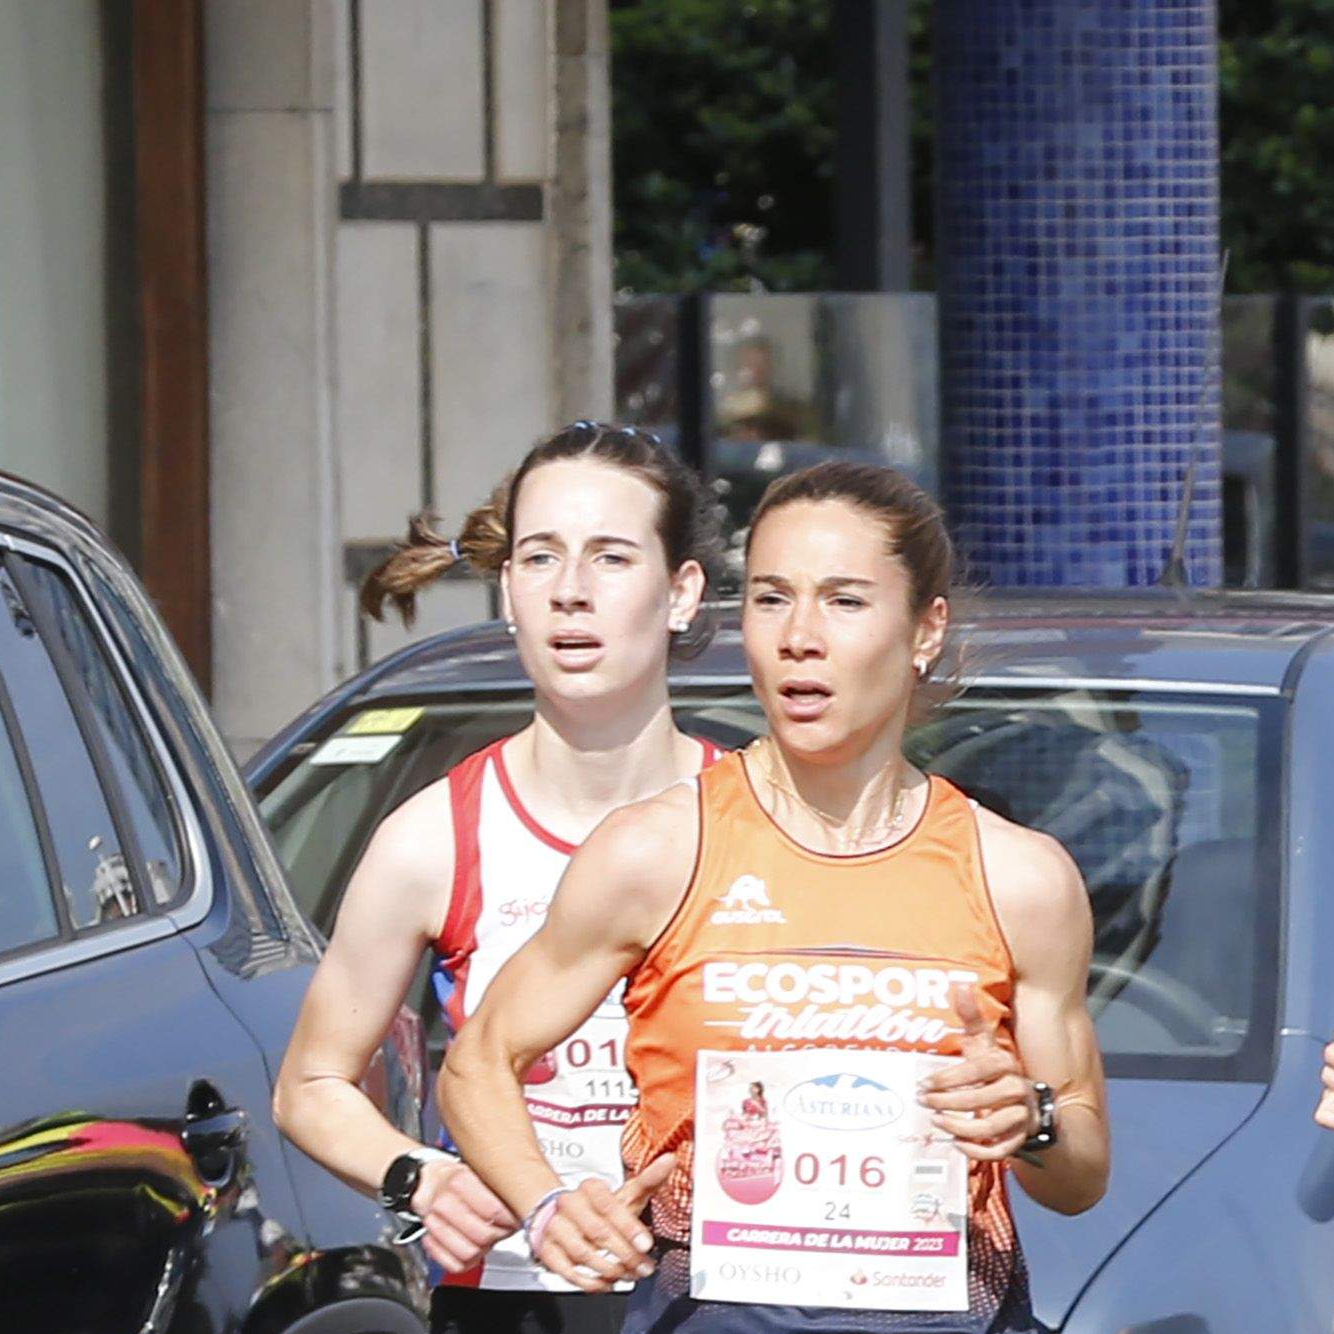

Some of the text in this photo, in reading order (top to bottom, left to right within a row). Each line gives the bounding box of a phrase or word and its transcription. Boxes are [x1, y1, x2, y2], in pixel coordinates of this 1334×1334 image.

[566, 1038, 620, 1068] 01
[583, 1108, 607, 1122] DE
[609, 1108, 630, 1121] LA
[795, 1095, 895, 1117] ASTURIANA
[793, 1153, 887, 1188] 016
[823, 1201, 851, 1221] 24
[727, 1228, 801, 1246] CARRERA
[804, 1232, 829, 1248] DE
[830, 1234, 854, 1249] LA
[854, 1235, 910, 1251] MUJER
[718, 1261, 801, 1286] OYSHO
[873, 1271, 947, 1289] Santander
